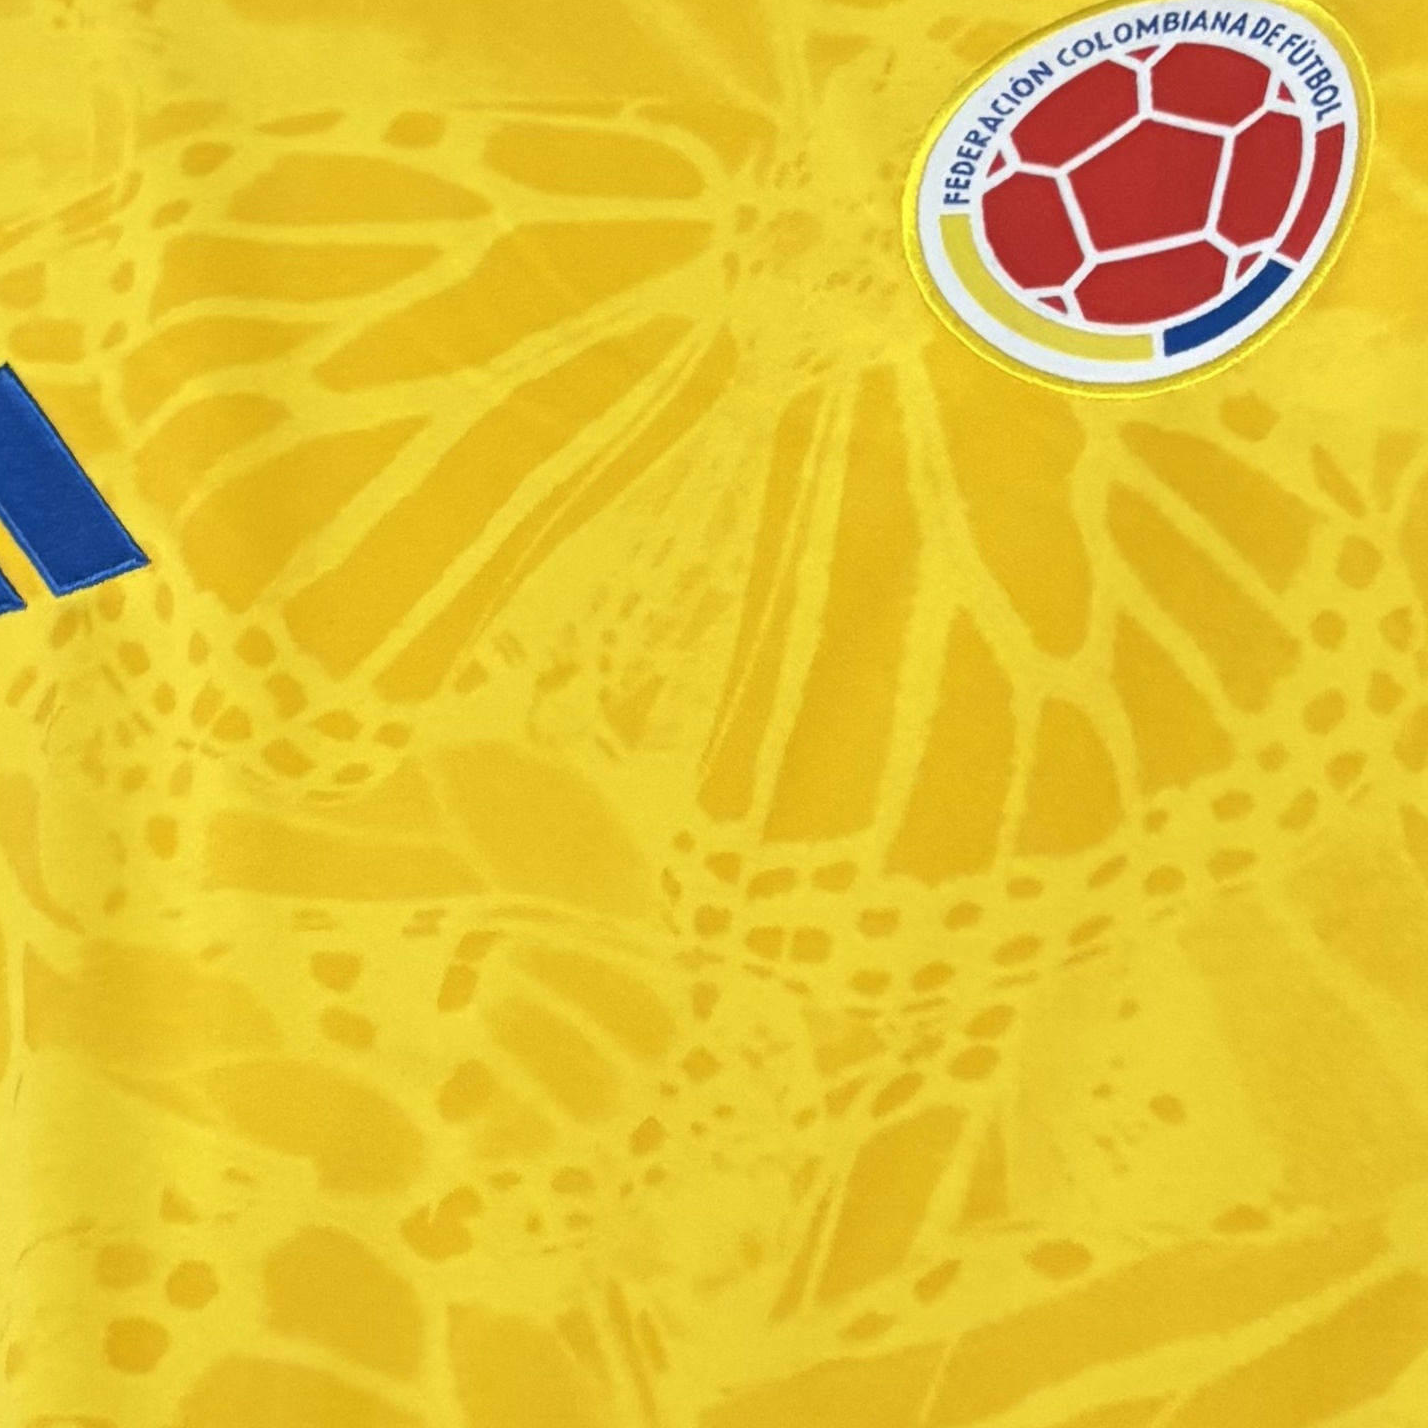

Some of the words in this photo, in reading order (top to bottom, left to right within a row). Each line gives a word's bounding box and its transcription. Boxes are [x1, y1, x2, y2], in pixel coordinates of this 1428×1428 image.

[943, 60, 1054, 205] FEDERACIÓN
[1056, 10, 1248, 67] COLOMBIANA
[1248, 16, 1287, 47] DE
[1277, 33, 1341, 122] FÚTBOL
